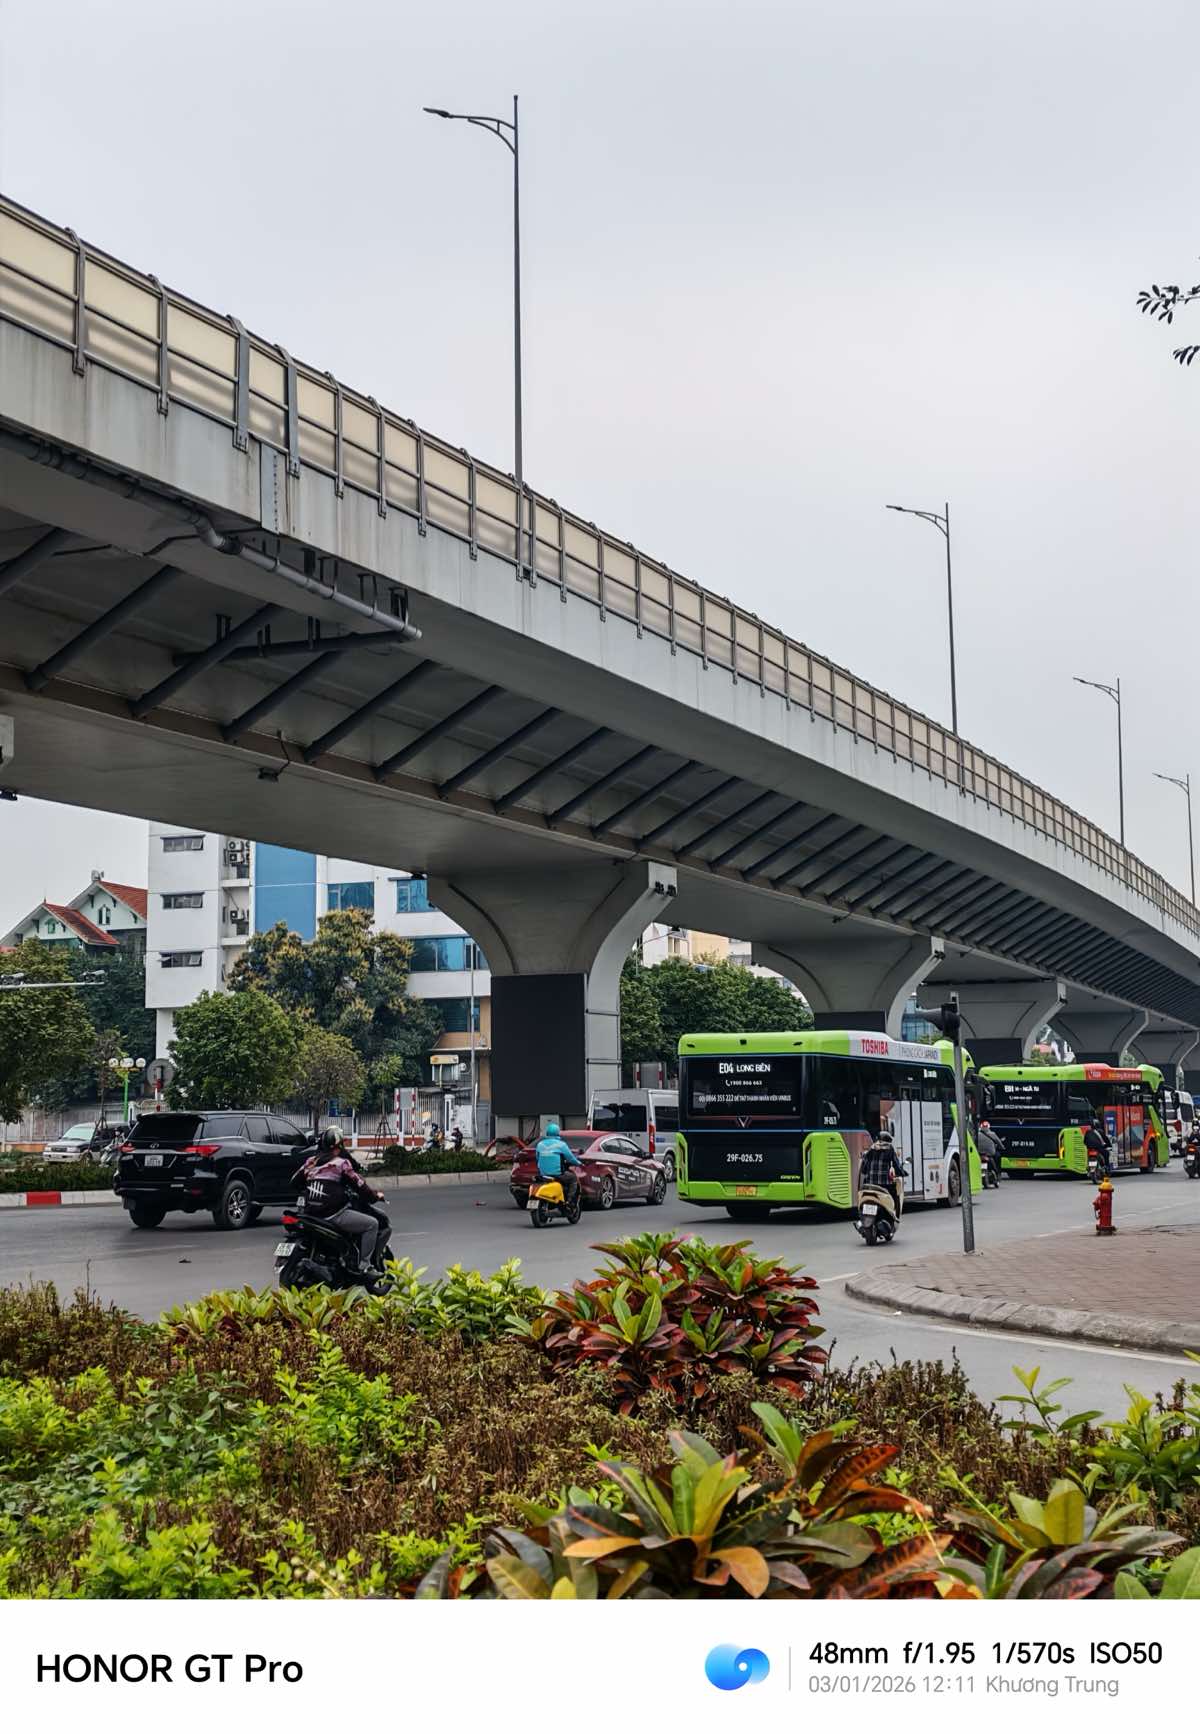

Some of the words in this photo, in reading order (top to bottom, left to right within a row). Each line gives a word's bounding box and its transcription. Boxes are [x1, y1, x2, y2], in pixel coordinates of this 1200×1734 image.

[862, 1039, 889, 1056] TOSHIBA
[719, 1062, 734, 1074] E04
[736, 1064, 755, 1073] LONG
[725, 1094, 734, 1102] 222
[726, 1153, 763, 1163] 29F-026.75
